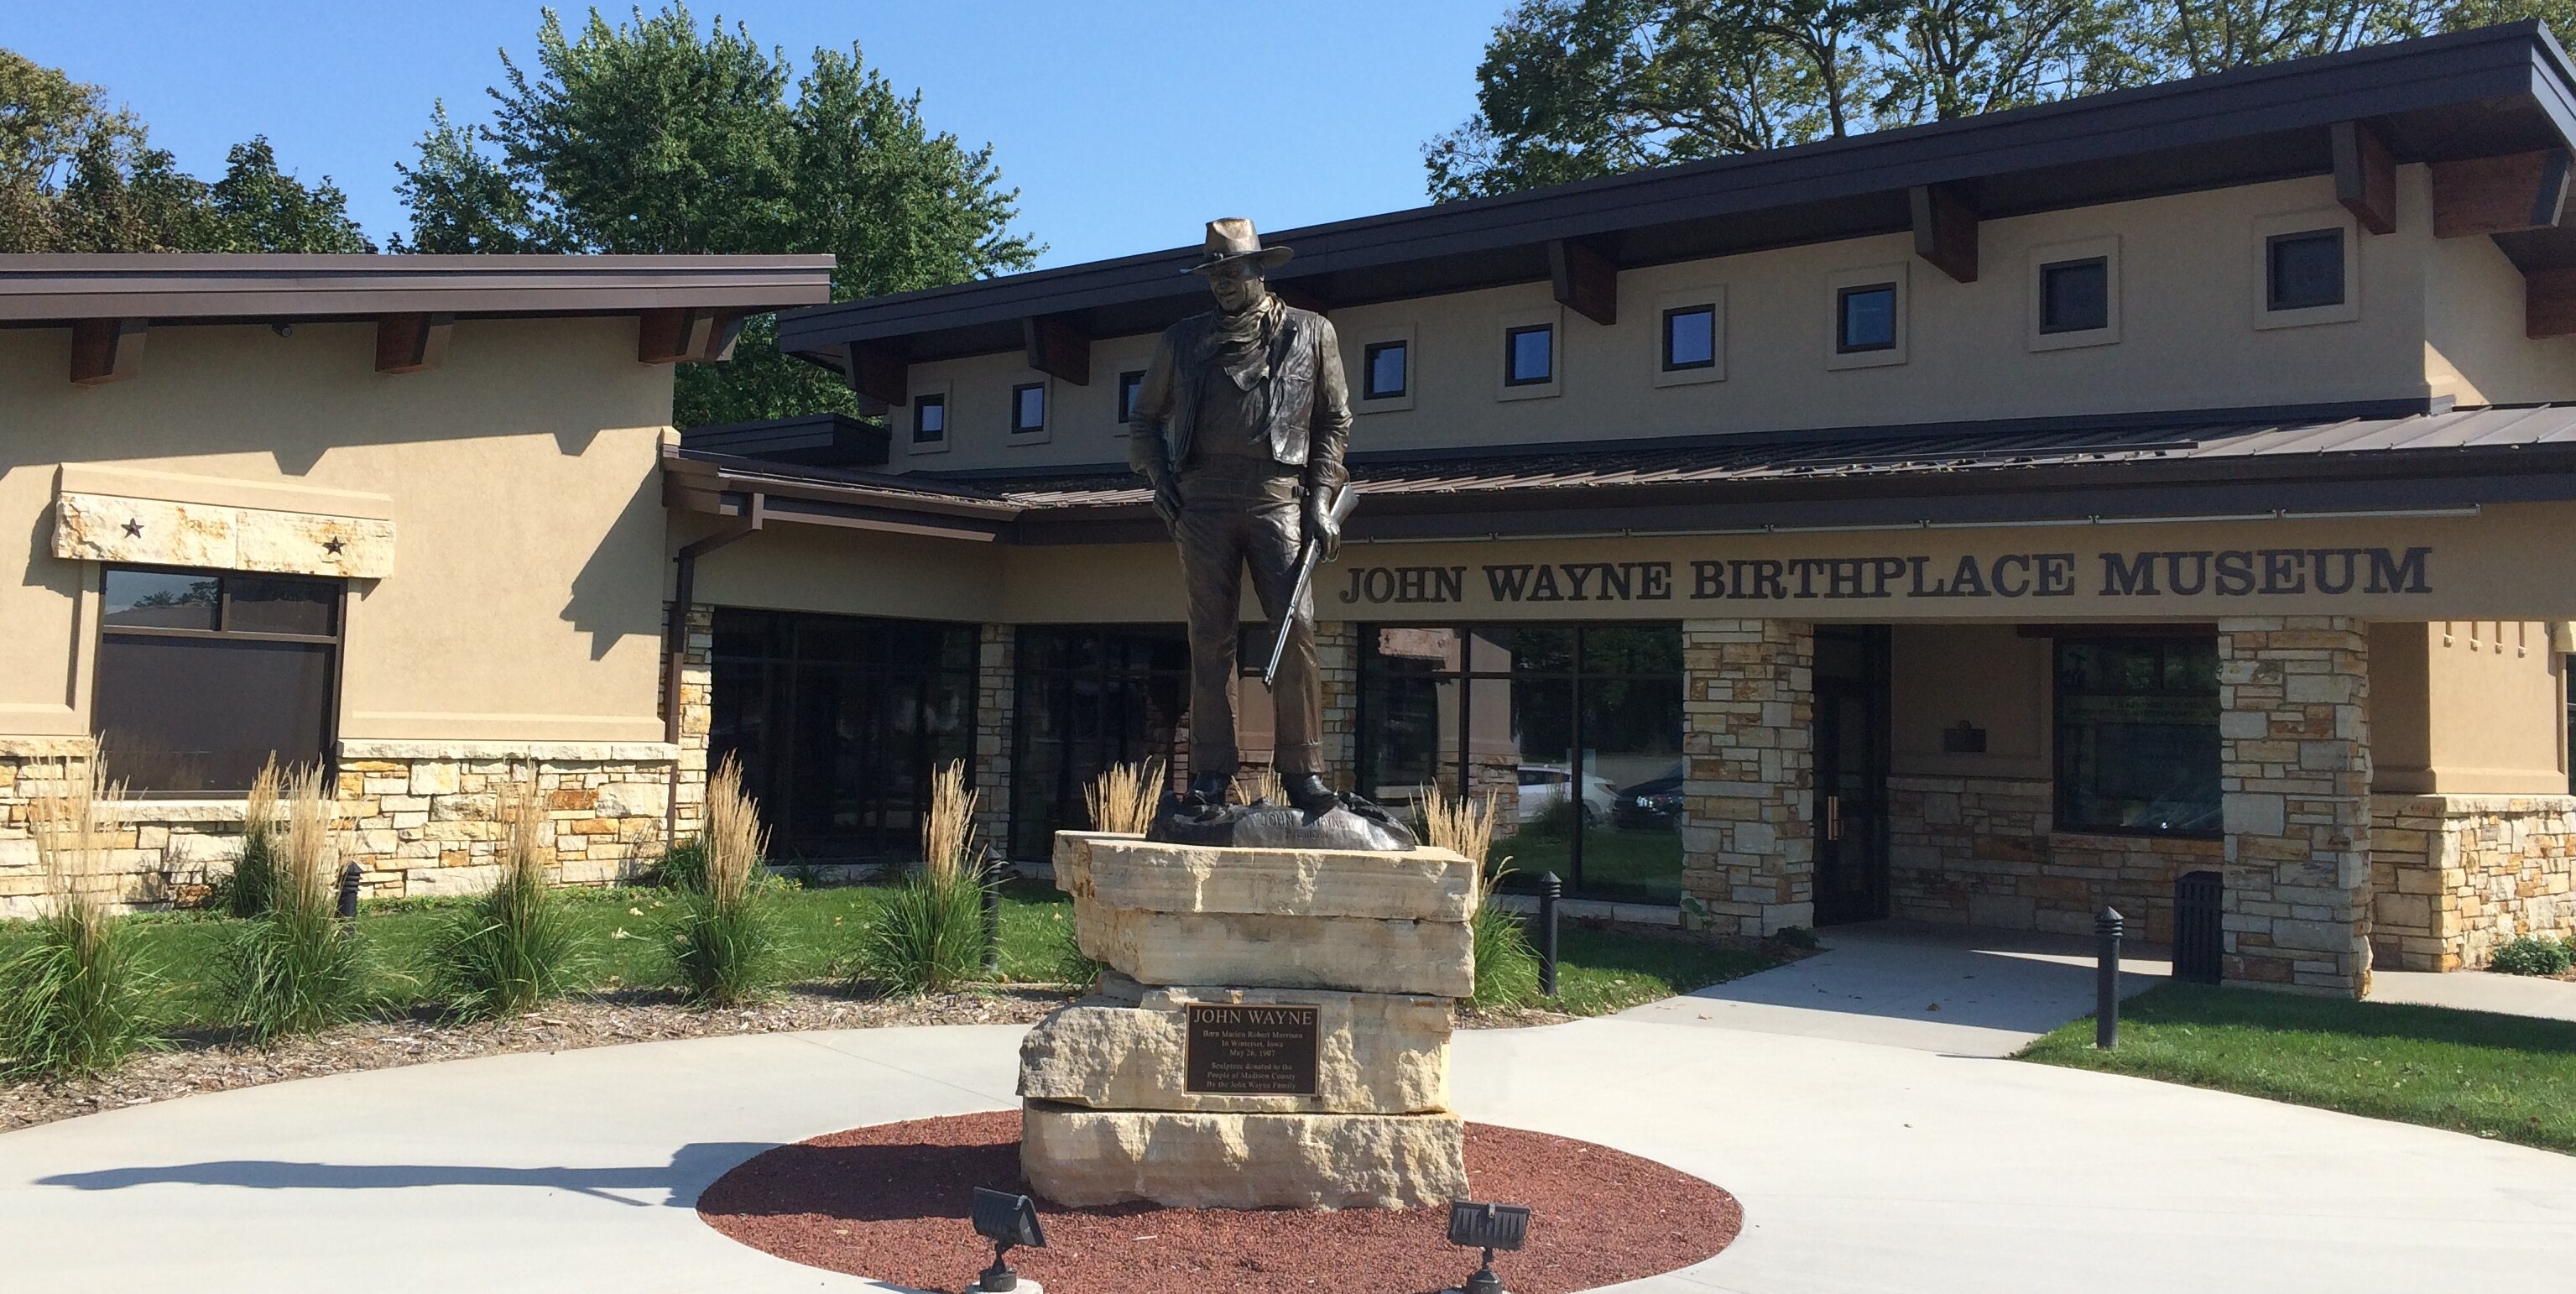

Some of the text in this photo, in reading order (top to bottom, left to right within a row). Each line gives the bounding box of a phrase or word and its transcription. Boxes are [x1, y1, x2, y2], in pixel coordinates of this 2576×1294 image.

[1340, 547, 2433, 603] JOHN WAYNE BIRTHPLACE MUSEUM
[1260, 812, 1346, 829] JOHN WAYNE
[1194, 1010, 1312, 1025] JOHN WAYNE
[1230, 1049, 1244, 1057] May
[1212, 1062, 1244, 1071] Sculpture
[1272, 1072, 1296, 1081] County
